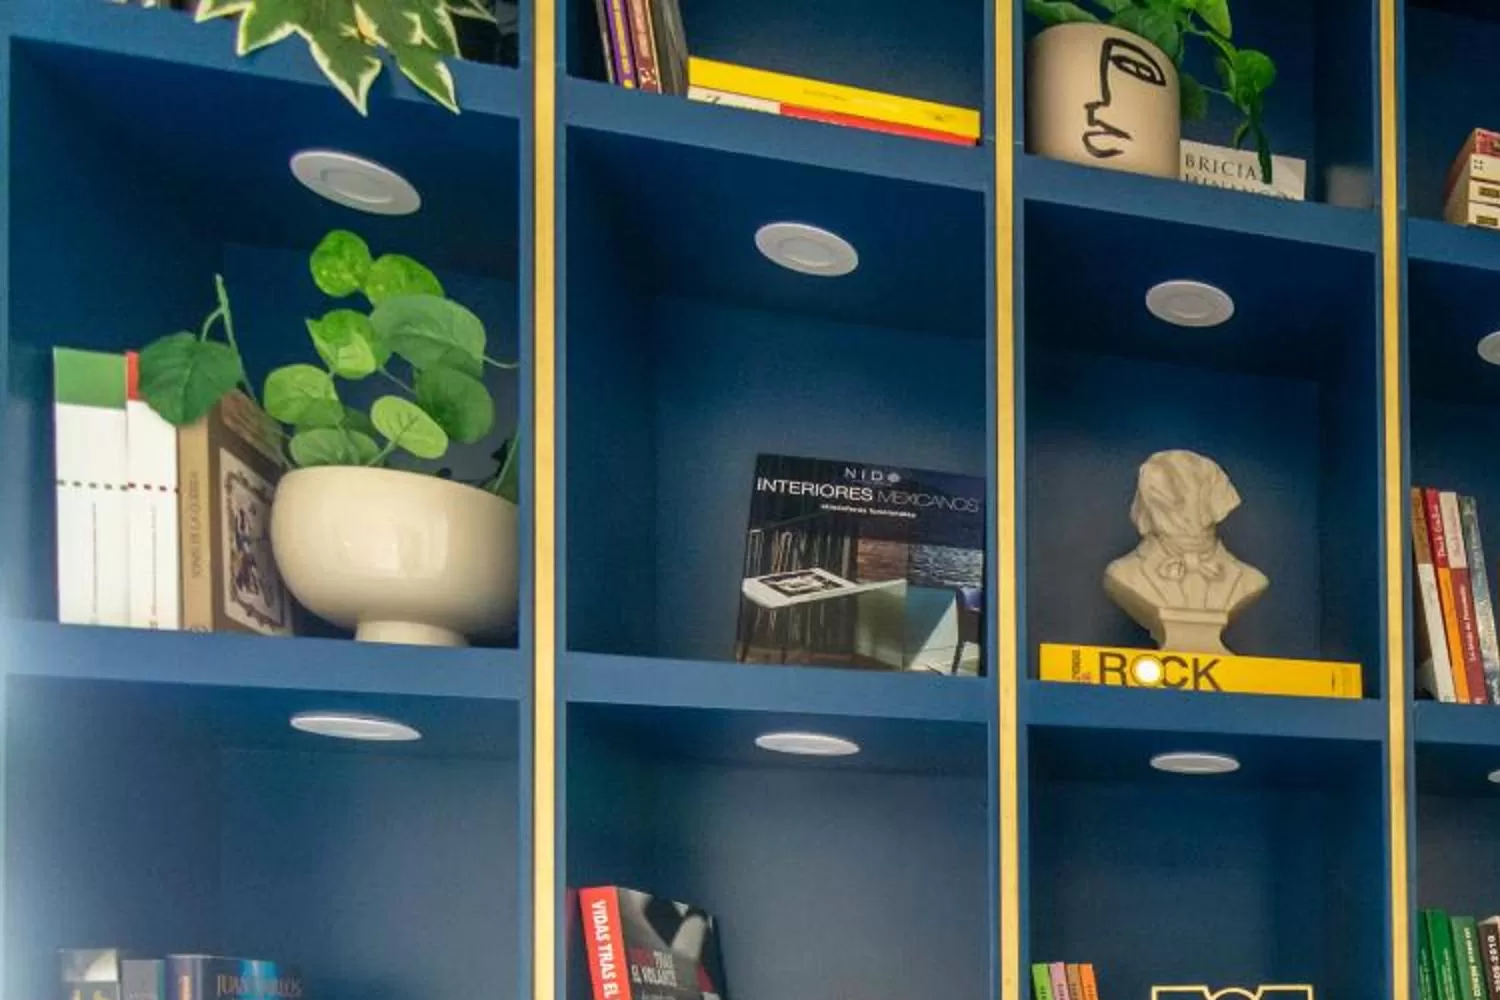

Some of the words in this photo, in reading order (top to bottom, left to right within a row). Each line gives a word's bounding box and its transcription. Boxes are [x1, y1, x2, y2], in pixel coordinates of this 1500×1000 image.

[1184, 153, 1257, 182] BRICIA
[756, 477, 873, 502] INTERIORES
[876, 489, 981, 513] MEXICANOS
[1099, 651, 1223, 691] ROCK
[590, 899, 610, 942] VIDAS
[597, 942, 615, 982] TRAS
[603, 983, 616, 998] EL
